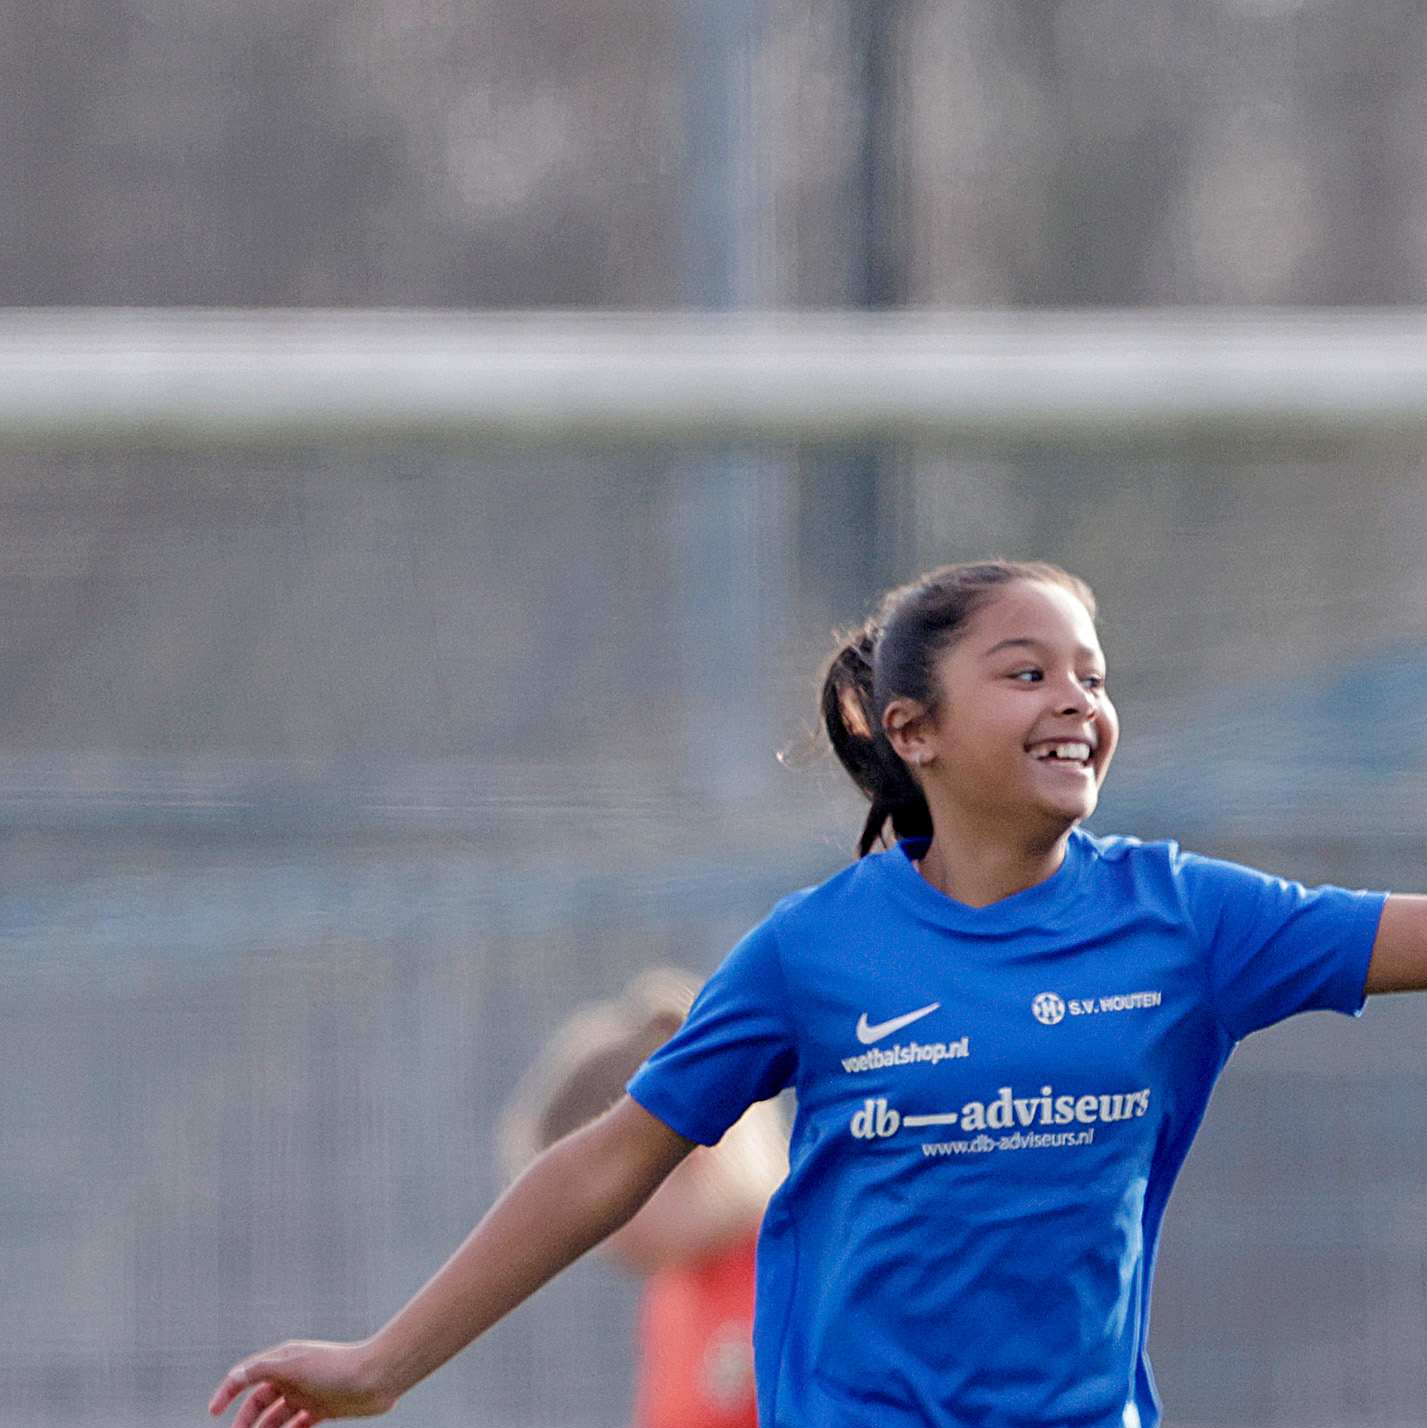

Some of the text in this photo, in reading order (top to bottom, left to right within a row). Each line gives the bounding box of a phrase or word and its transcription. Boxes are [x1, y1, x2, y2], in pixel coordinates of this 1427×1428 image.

[1068, 1000, 1099, 1015] S.V.
[1100, 992, 1161, 1012] HOUTEN
[841, 1036, 969, 1073] voetbalshop.nl
[922, 1128, 1094, 1157] www.db-adviseurs.nl
